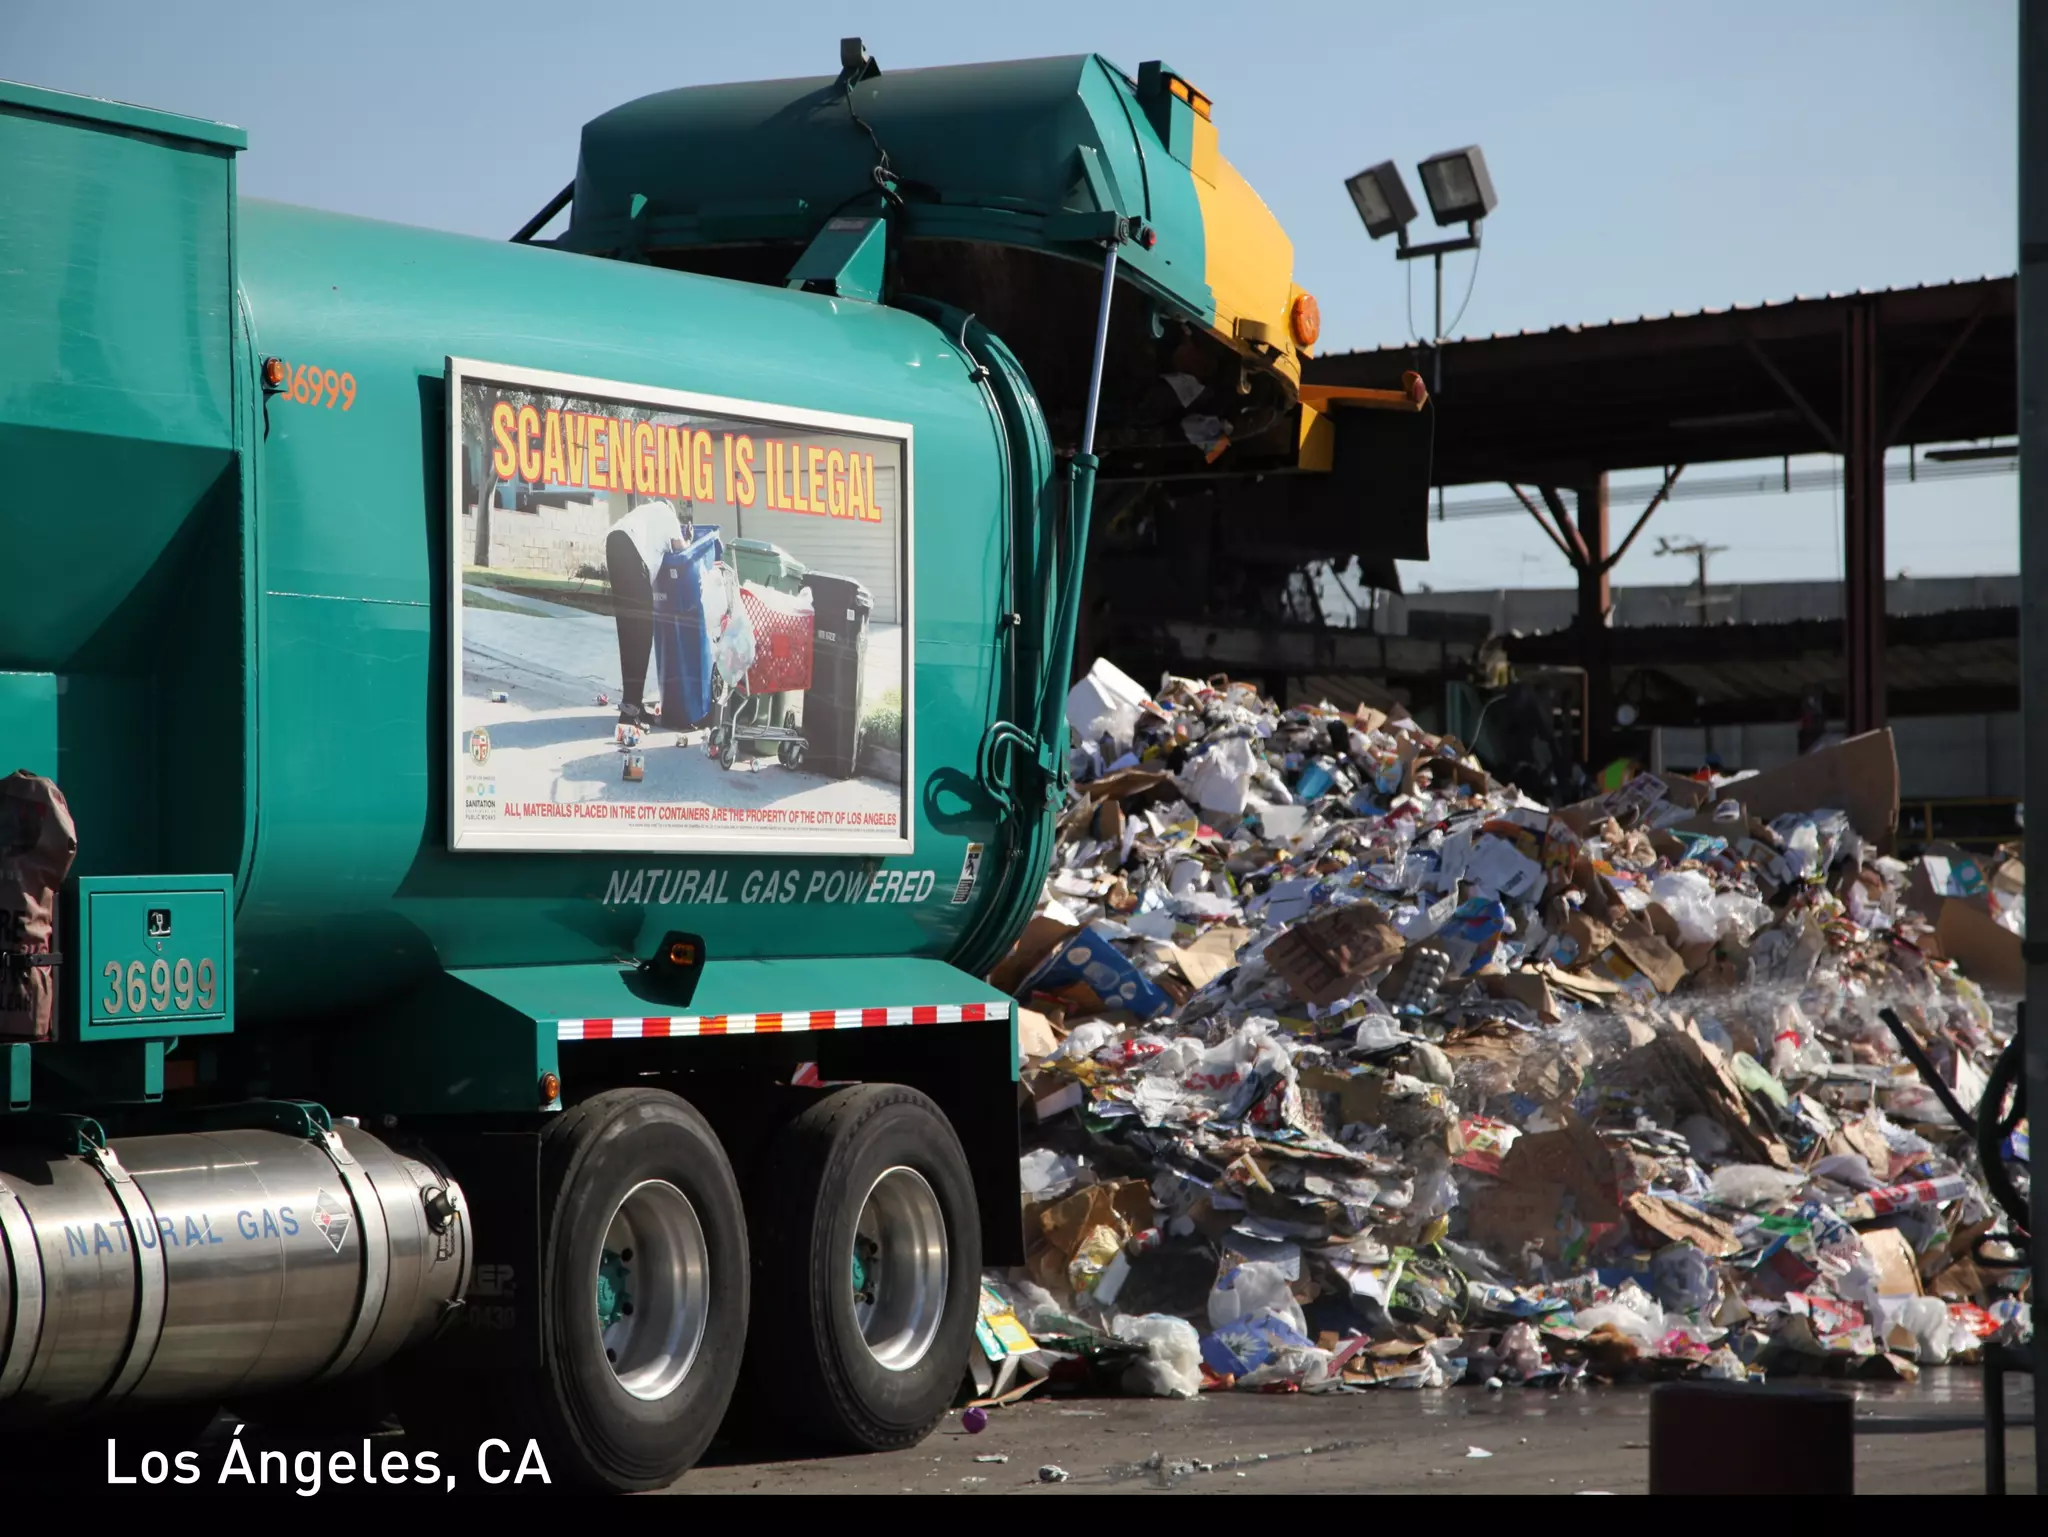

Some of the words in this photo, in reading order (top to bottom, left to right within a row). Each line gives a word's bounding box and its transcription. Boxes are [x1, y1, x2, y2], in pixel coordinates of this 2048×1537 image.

[491, 401, 715, 504] SCAVENGING
[723, 433, 757, 508] IS
[764, 439, 882, 523] ILLEGAL
[465, 799, 496, 808] SANITATION
[504, 802, 521, 817] ALL
[523, 803, 572, 818] MATERIALS
[574, 803, 608, 819] PLACED
[610, 805, 618, 818] IN
[620, 805, 636, 819] THE
[638, 805, 657, 820] CITY
[659, 806, 710, 822] CONTAINERS
[711, 808, 728, 821] ARE
[729, 808, 744, 822] THE
[746, 809, 787, 823] PROPERTY
[788, 810, 800, 823] OF
[800, 811, 815, 824] THE
[816, 811, 834, 825] CITY
[835, 811, 846, 825] OF
[847, 812, 861, 825] LOS
[863, 812, 897, 826] ANGELES
[602, 869, 729, 905] NATURAL
[740, 869, 800, 904] GAS
[803, 869, 936, 905] POWERED
[103, 958, 216, 1014] 36999
[63, 1212, 224, 1258] NATURAL
[236, 1206, 300, 1241] GAS
